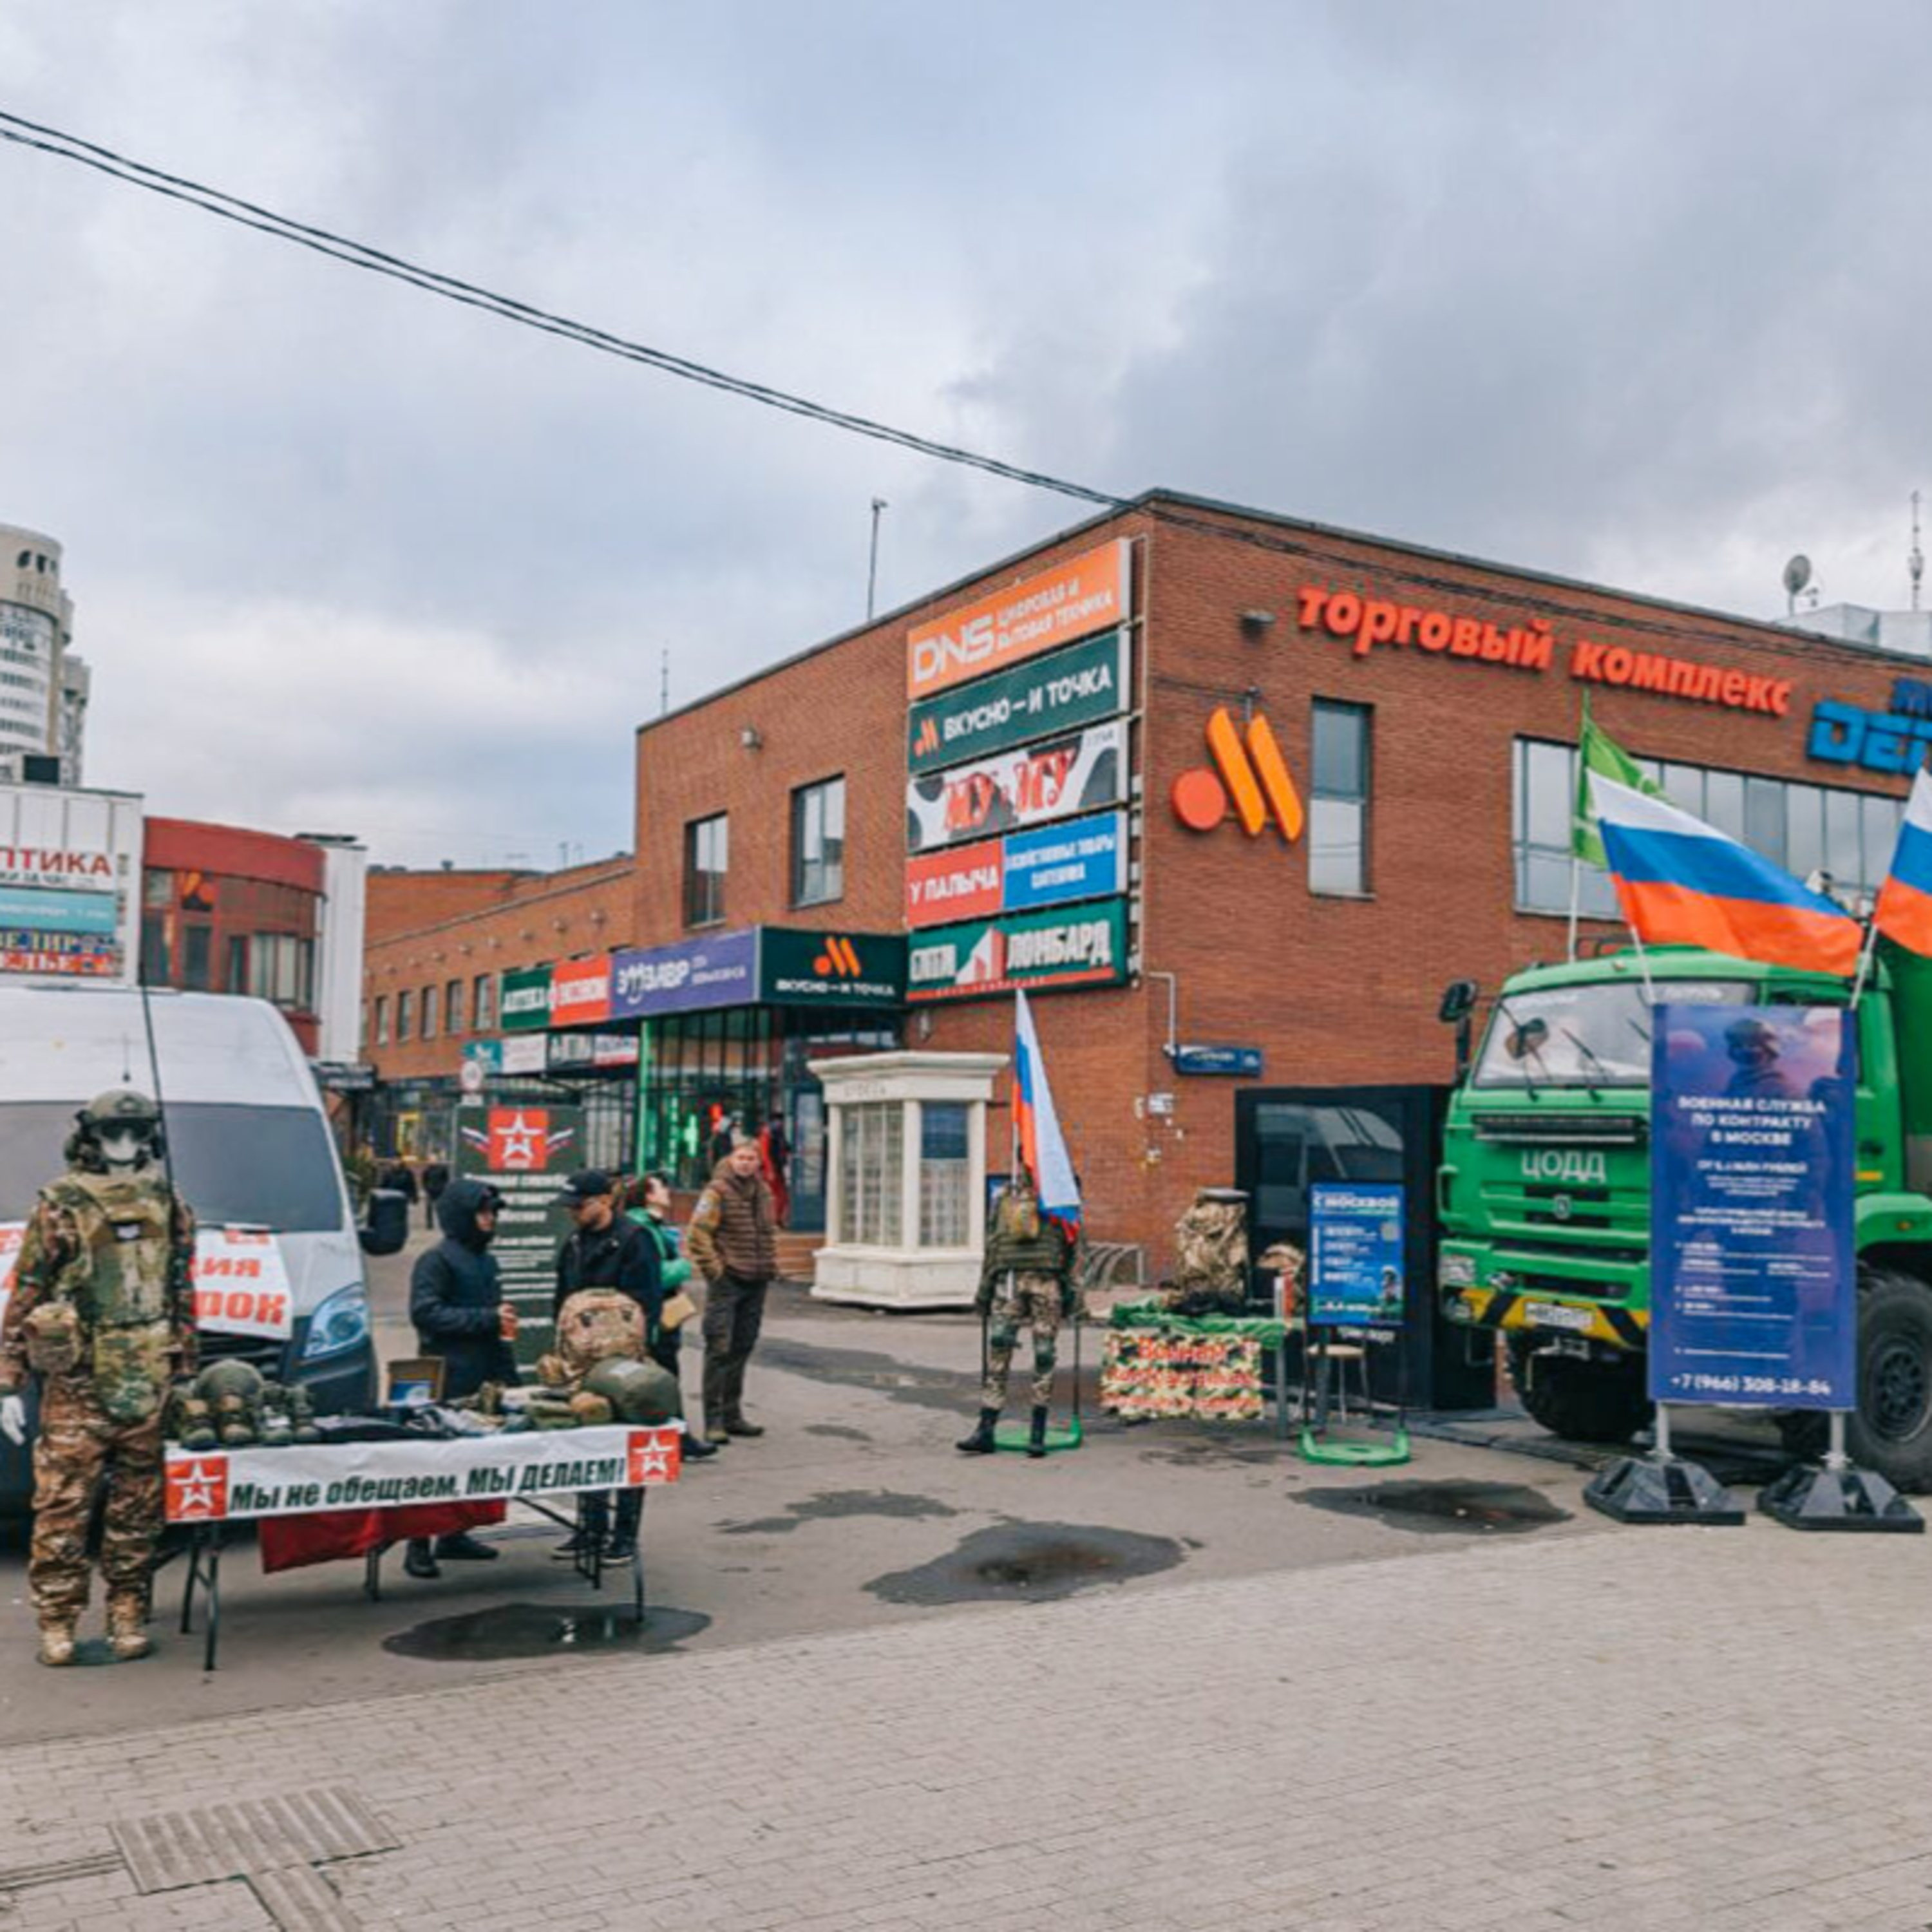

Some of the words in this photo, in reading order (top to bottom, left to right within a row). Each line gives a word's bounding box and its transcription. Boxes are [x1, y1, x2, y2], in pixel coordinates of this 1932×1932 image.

[914, 615, 994, 683] DNS
[1298, 585, 1555, 670] торговый
[1571, 638, 1792, 717] комплекс
[943, 697, 1009, 741] ВКУСНО
[1047, 664, 1113, 706] ТОЧКА
[910, 882, 922, 905] У
[925, 866, 999, 900] ПАЛЫЧА
[1008, 920, 1111, 970] ЛОМБАРД
[1678, 1097, 1753, 1110] ВОЕННАЯ
[1756, 1098, 1826, 1113] СЛУЖБА
[1692, 1113, 1714, 1126] ПО
[1718, 1115, 1812, 1129] КОНТРАКТУ
[1711, 1131, 1721, 1142] В
[1725, 1132, 1792, 1146] МОСКВЕ
[1522, 1151, 1605, 1183] ЦОДД
[230, 1481, 279, 1511] Мы
[285, 1483, 319, 1508] не
[466, 1468, 516, 1495] МЫ
[519, 1457, 625, 1494] ДЕЛАЕМ!
